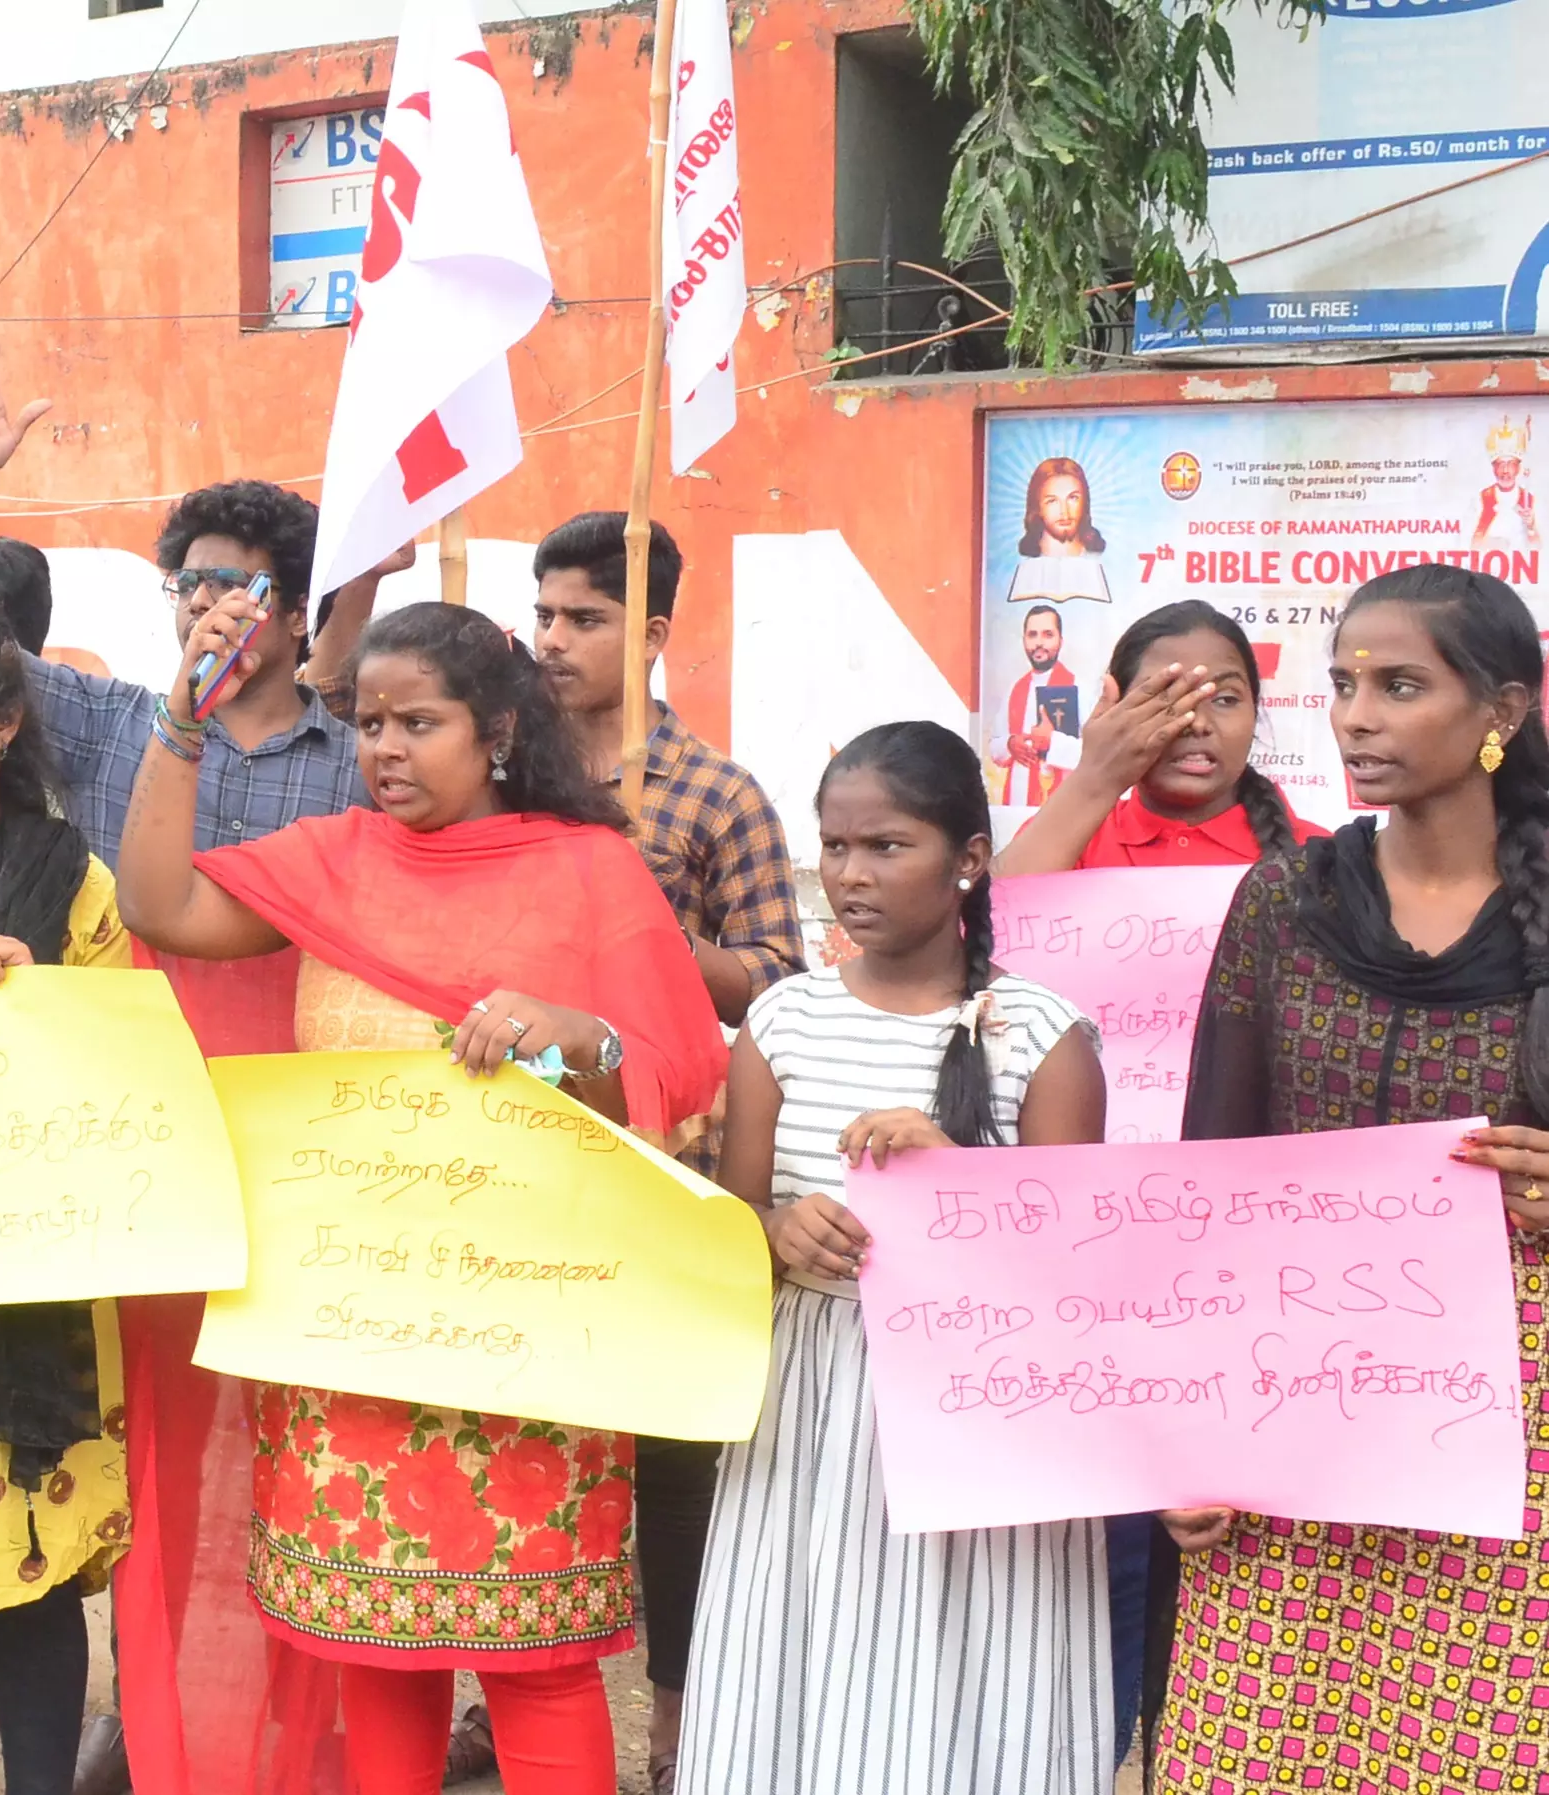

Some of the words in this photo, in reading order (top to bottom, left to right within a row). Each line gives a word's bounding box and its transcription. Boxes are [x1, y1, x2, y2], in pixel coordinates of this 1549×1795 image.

[1252, 149, 1294, 165] back
[1301, 147, 1346, 163] offer
[1352, 144, 1371, 160] of
[1378, 140, 1443, 158] Rs.50/
[1449, 135, 1509, 155] month
[1517, 134, 1547, 150] for
[1267, 303, 1306, 319] TOLL
[1226, 460, 1247, 471] will
[1249, 461, 1281, 473] praise
[1346, 461, 1381, 472] among
[1384, 459, 1401, 469] the
[1239, 475, 1260, 486] will
[1263, 475, 1285, 488] sing
[1287, 475, 1305, 485] the
[1307, 475, 1345, 487] praises
[1347, 474, 1358, 484] of
[1360, 475, 1385, 487] your
[1289, 489, 1332, 502] (Psalms
[1188, 520, 1257, 536] DIOCESE
[1261, 520, 1282, 536] OF
[1287, 519, 1461, 536] RAMANATHAPURAM
[1185, 550, 1281, 584] BIBLE
[1266, 607, 1280, 624] &
[1287, 606, 1312, 624] 27
[1303, 694, 1327, 708] CST
[927, 1178, 1060, 1240] காசி
[1072, 1172, 1215, 1251] தமிழ்
